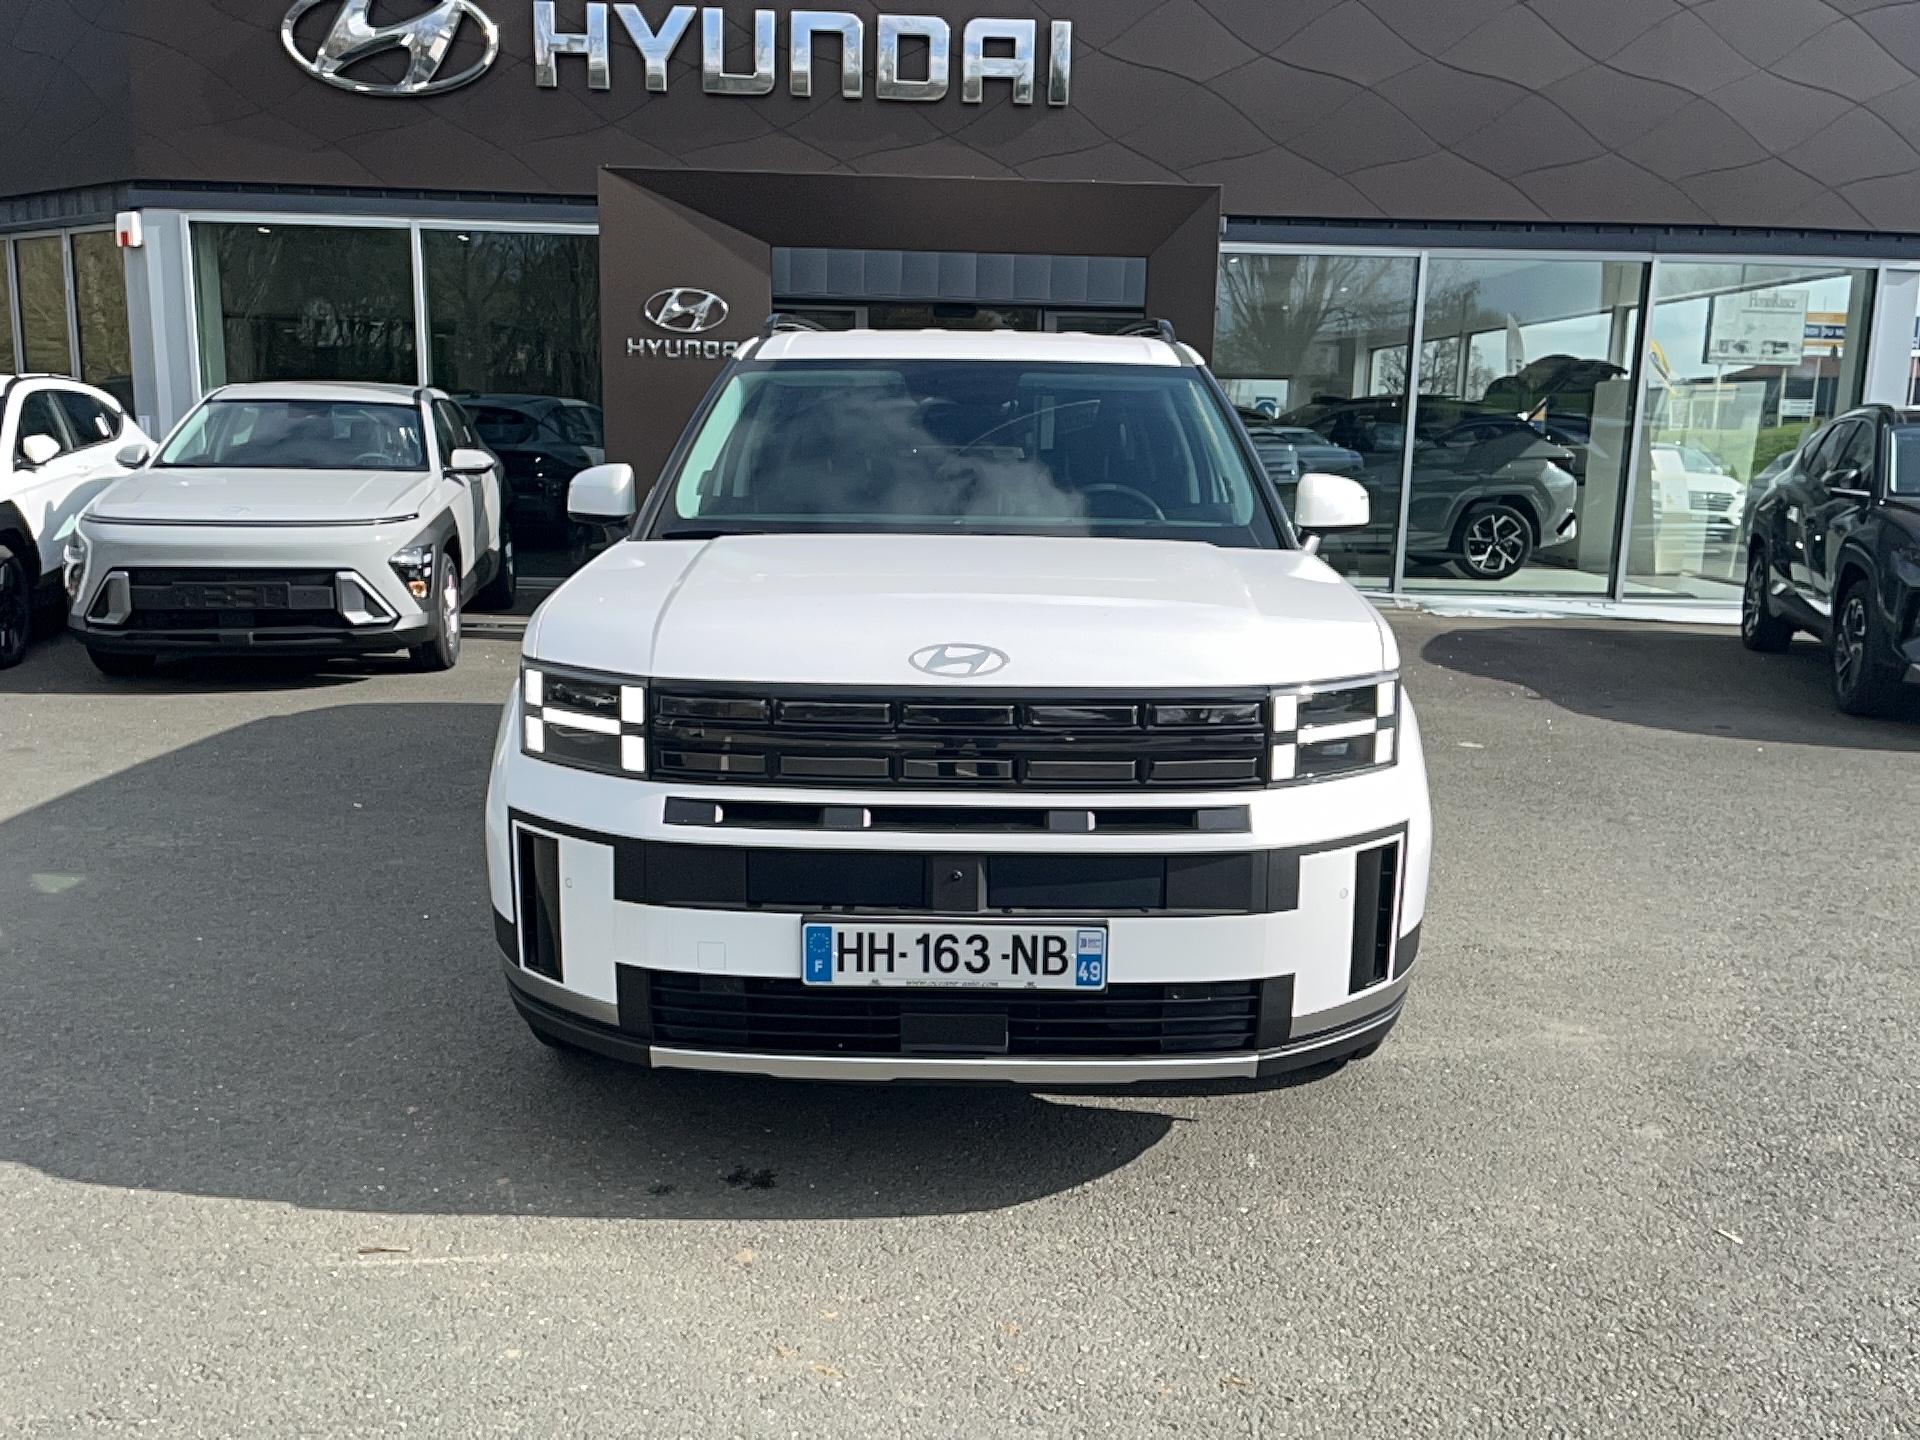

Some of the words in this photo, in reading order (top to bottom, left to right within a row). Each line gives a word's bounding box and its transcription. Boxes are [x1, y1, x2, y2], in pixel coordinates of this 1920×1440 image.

[533, 1, 1072, 106] HYUNDAI
[627, 336, 740, 360] HYUNDA
[814, 960, 823, 973] F
[1078, 960, 1100, 982] 49
